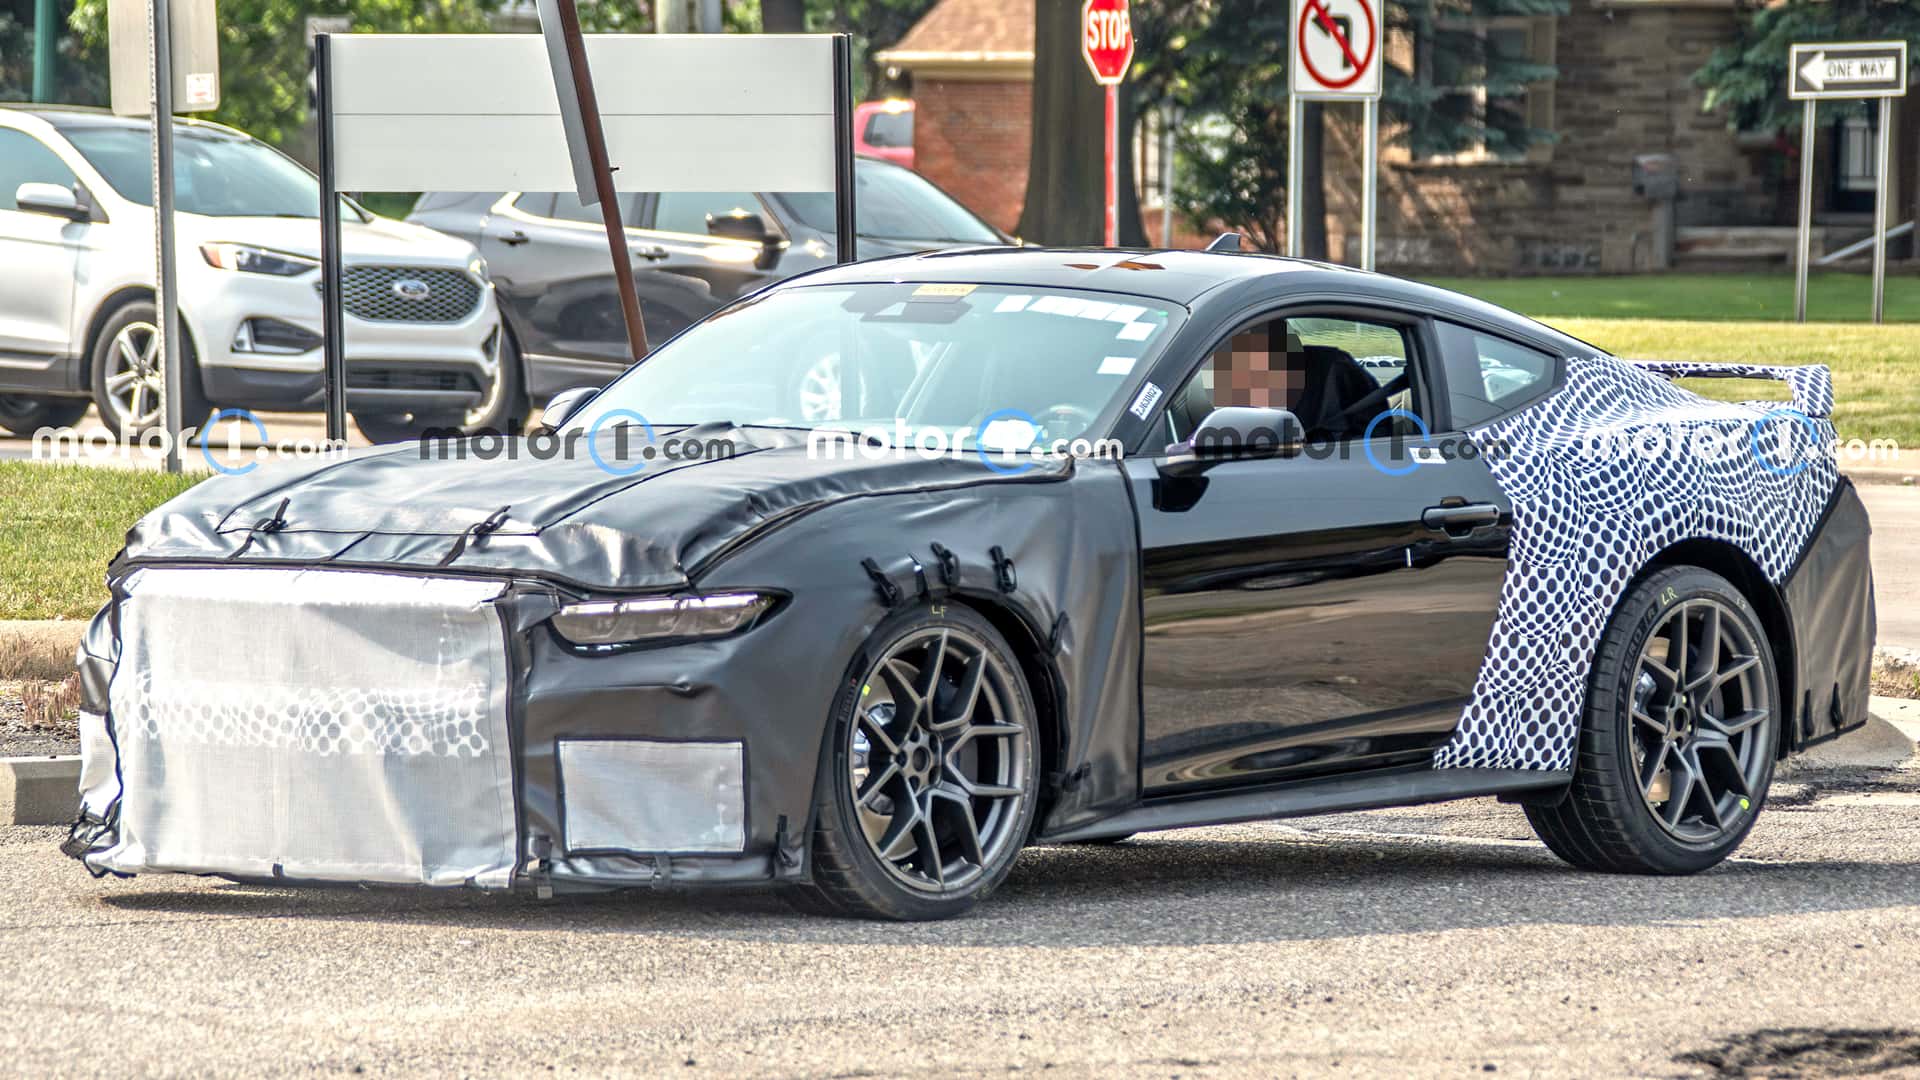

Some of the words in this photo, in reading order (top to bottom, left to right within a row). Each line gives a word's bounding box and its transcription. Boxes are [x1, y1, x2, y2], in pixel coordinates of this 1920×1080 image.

[1088, 9, 1129, 50] STOP
[1827, 62, 1852, 78] ONE
[1859, 62, 1887, 77] WAY
[1660, 586, 1679, 606] LR
